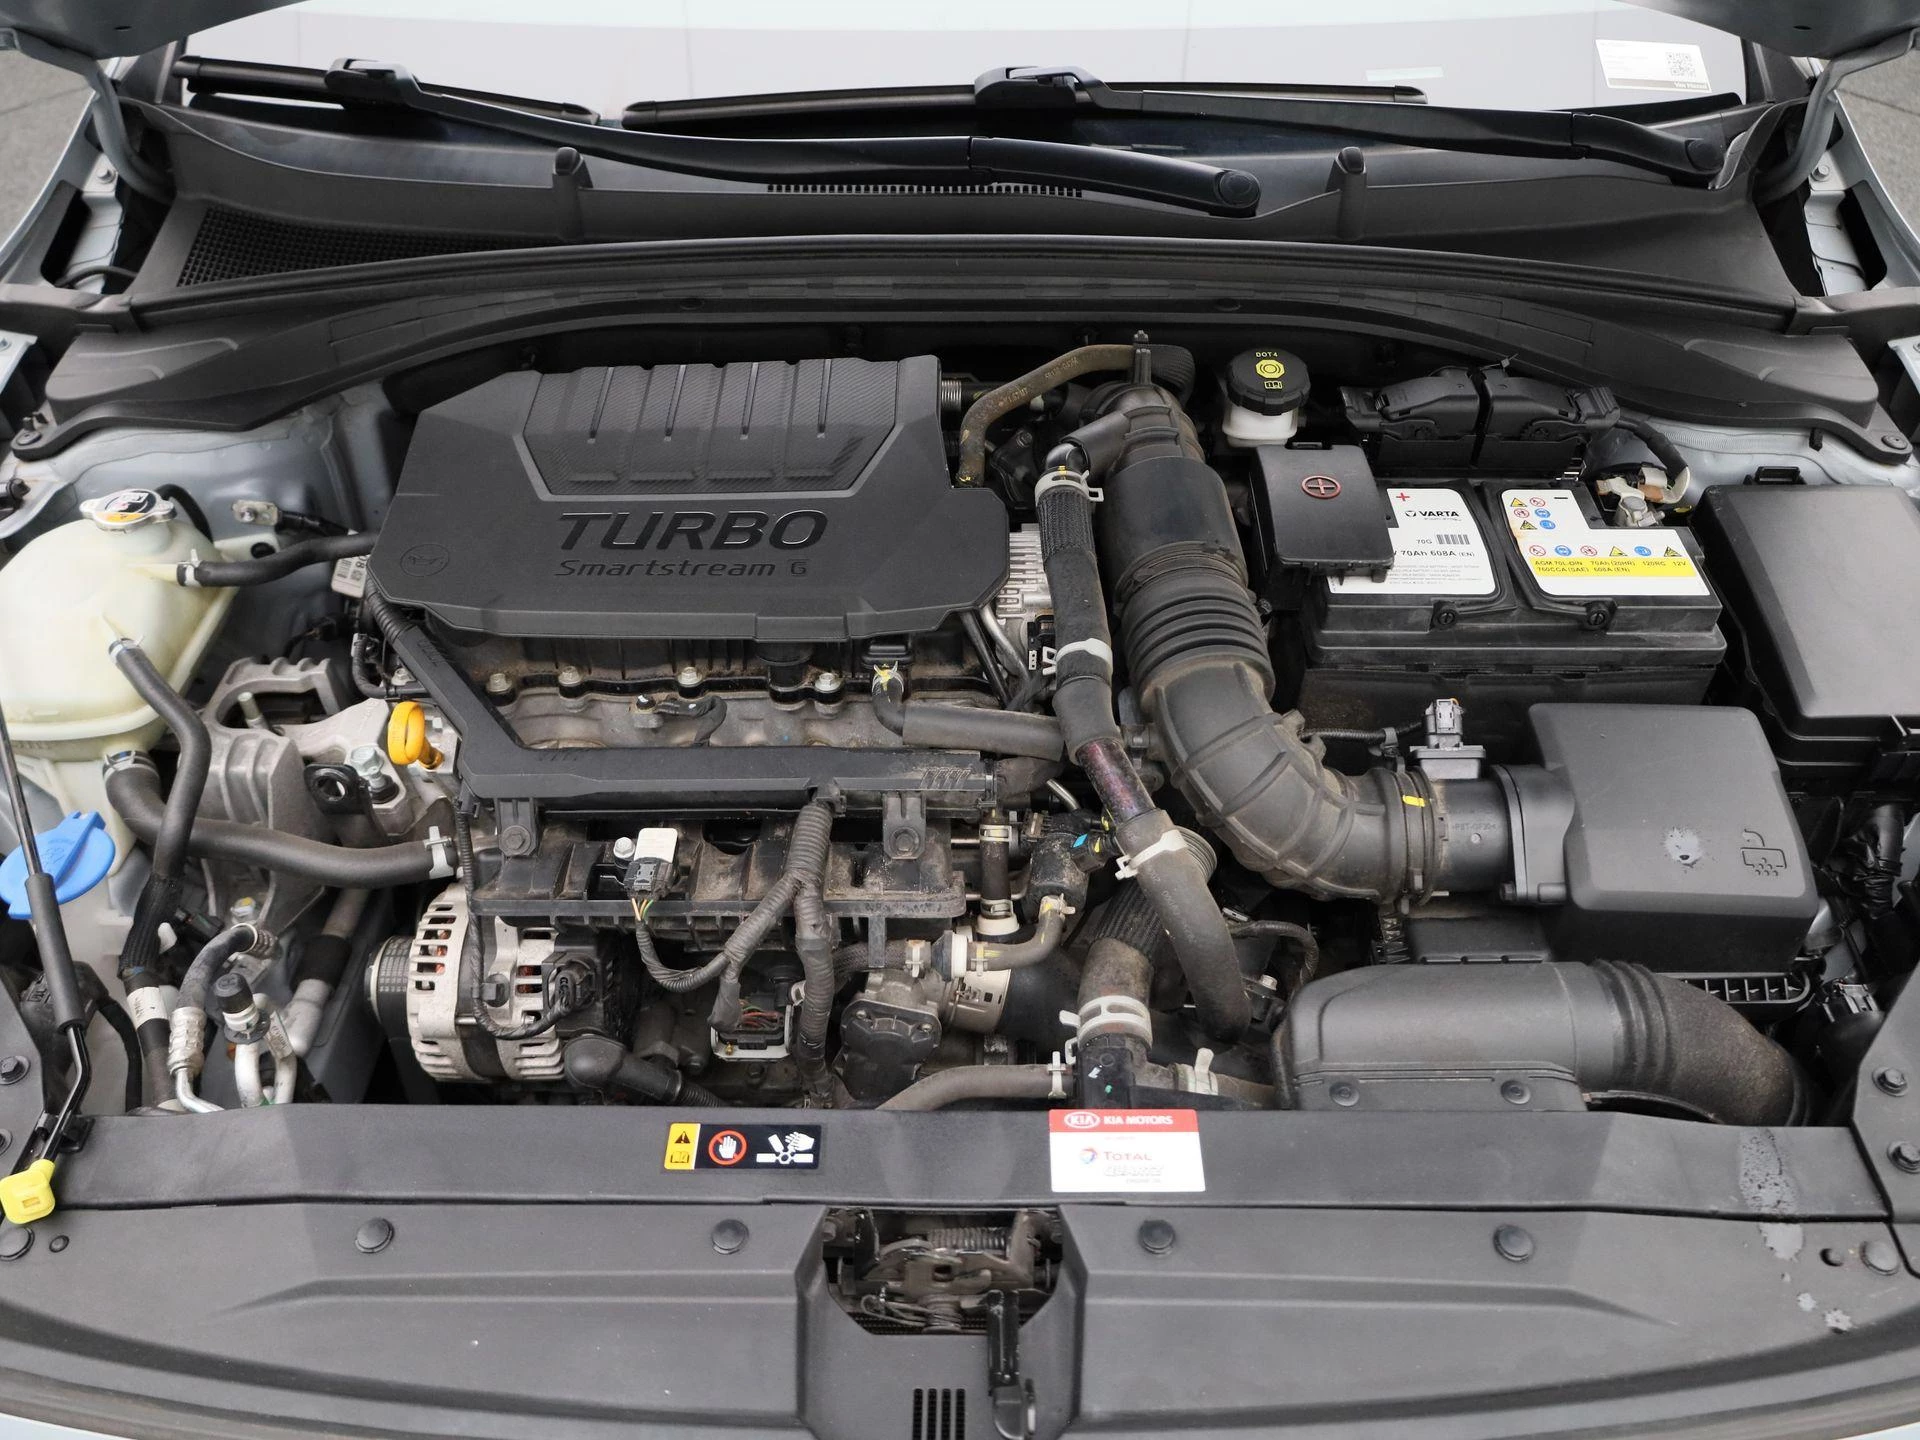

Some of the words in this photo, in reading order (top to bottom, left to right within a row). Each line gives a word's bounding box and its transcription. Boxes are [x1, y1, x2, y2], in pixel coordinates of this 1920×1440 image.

[560, 509, 828, 550] TURBO
[555, 560, 776, 576] Smartstream
[1103, 1115, 1125, 1125] KIA
[1126, 1115, 1174, 1125] MOTORS
